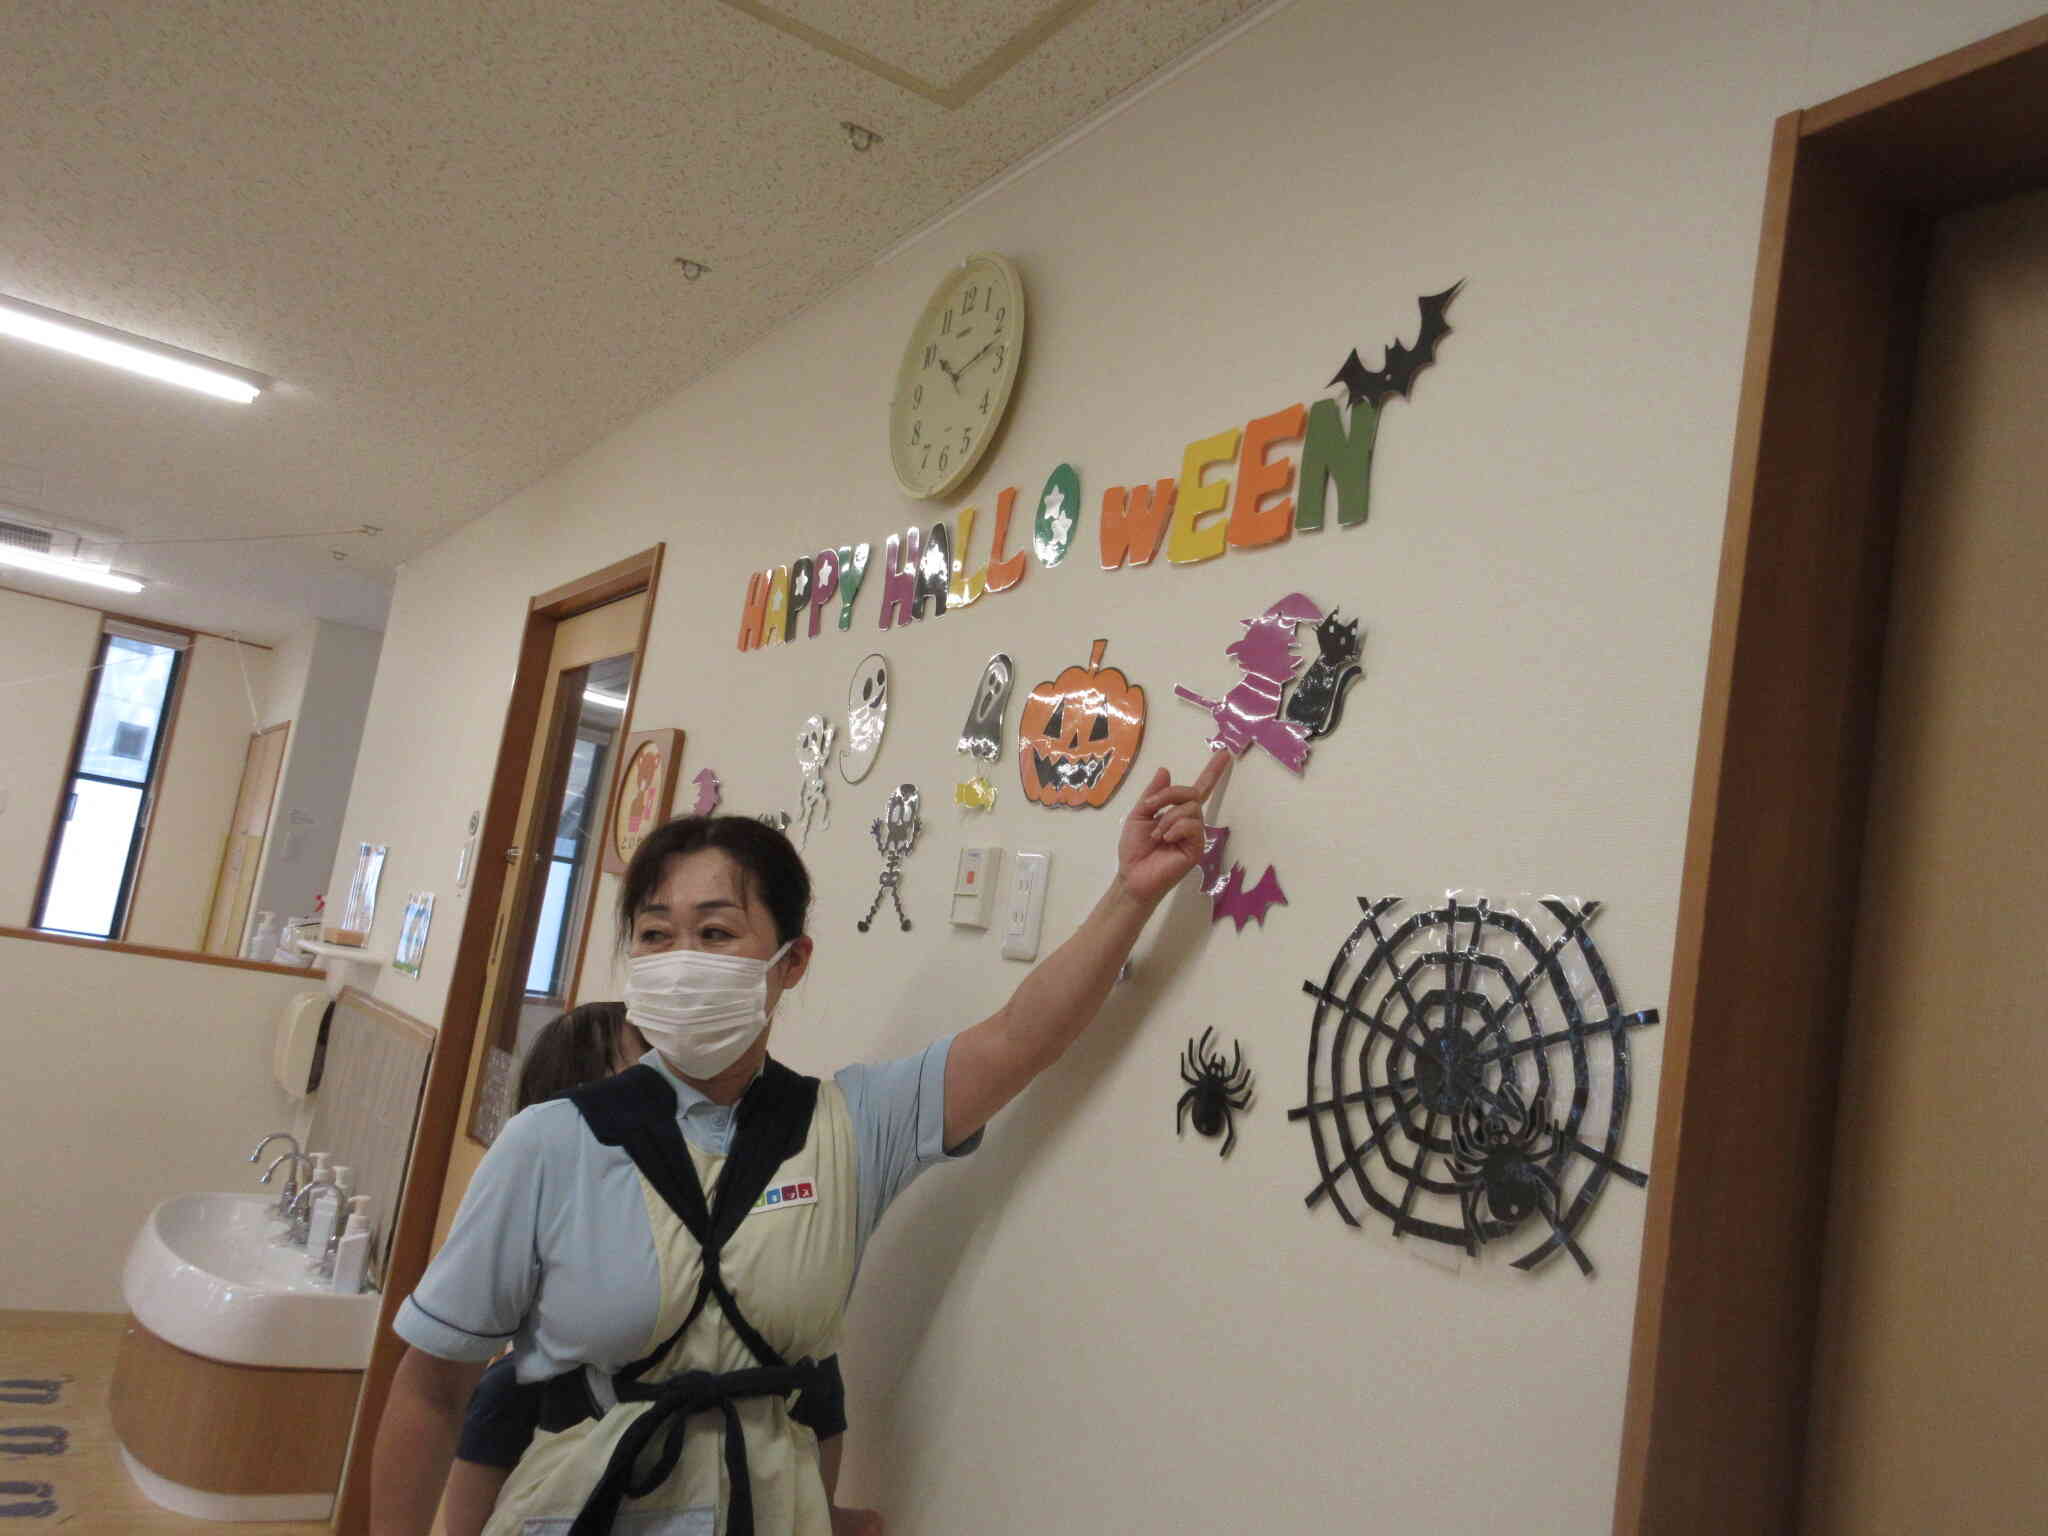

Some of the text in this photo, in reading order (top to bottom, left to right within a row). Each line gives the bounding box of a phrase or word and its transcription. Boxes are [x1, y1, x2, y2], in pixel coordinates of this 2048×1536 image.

[960, 286, 978, 316] 12
[984, 287, 992, 313] 1
[940, 309, 953, 336] 11
[994, 307, 1006, 335] 2
[922, 343, 937, 370] 10
[993, 345, 1006, 374] 3
[913, 384, 923, 410] 9
[978, 388, 990, 415] 4
[911, 420, 921, 446] 8
[960, 427, 972, 454] 5
[921, 444, 932, 470] 7
[938, 446, 950, 471] 6
[737, 398, 1382, 652] HAPPY HALLOWEEN
